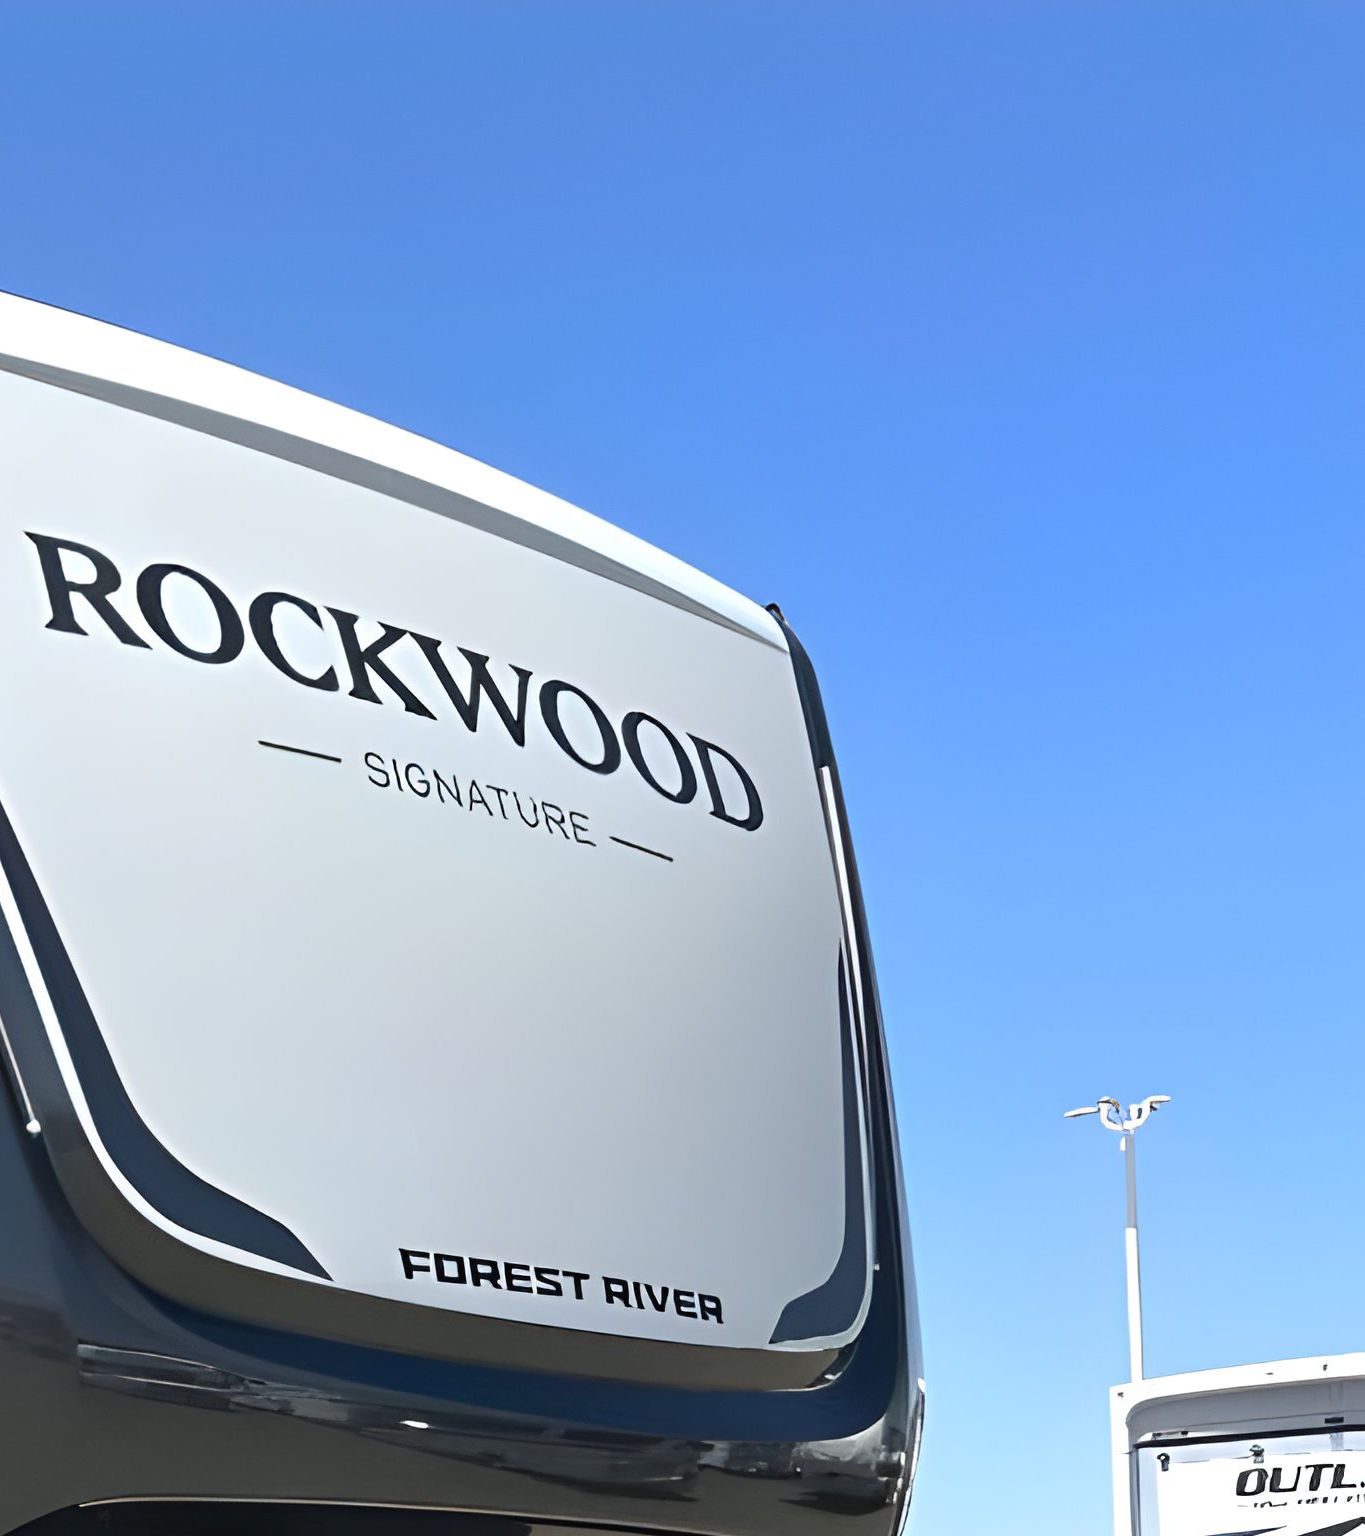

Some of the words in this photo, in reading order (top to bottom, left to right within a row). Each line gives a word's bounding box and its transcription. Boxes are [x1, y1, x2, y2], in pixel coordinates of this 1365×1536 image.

[24, 531, 765, 832] ROCKWOOD
[364, 752, 597, 847] SIGNATURE
[399, 1248, 590, 1300] FOREST
[602, 1276, 724, 1324] RIVER
[1236, 1464, 1365, 1496] OUTL
